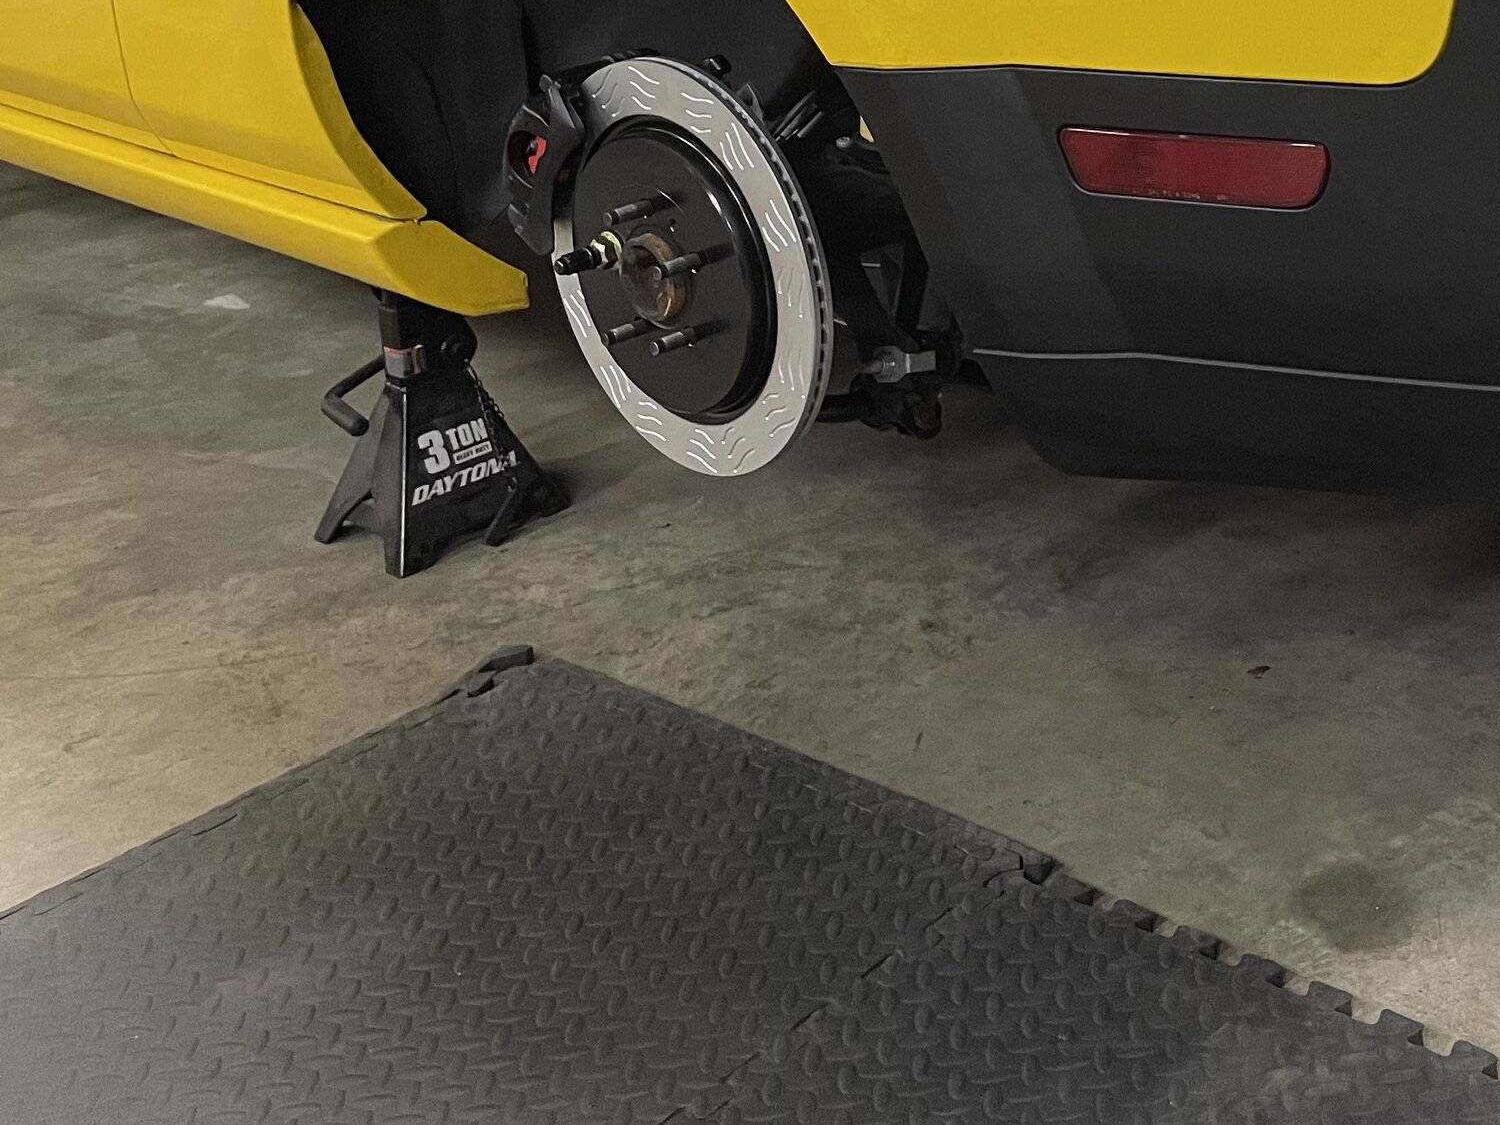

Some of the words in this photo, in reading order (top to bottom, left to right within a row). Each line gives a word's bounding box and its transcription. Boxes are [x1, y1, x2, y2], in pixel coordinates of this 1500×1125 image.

[417, 429, 451, 475] 3
[444, 417, 488, 451] TON
[411, 450, 517, 506] DAYTONA
